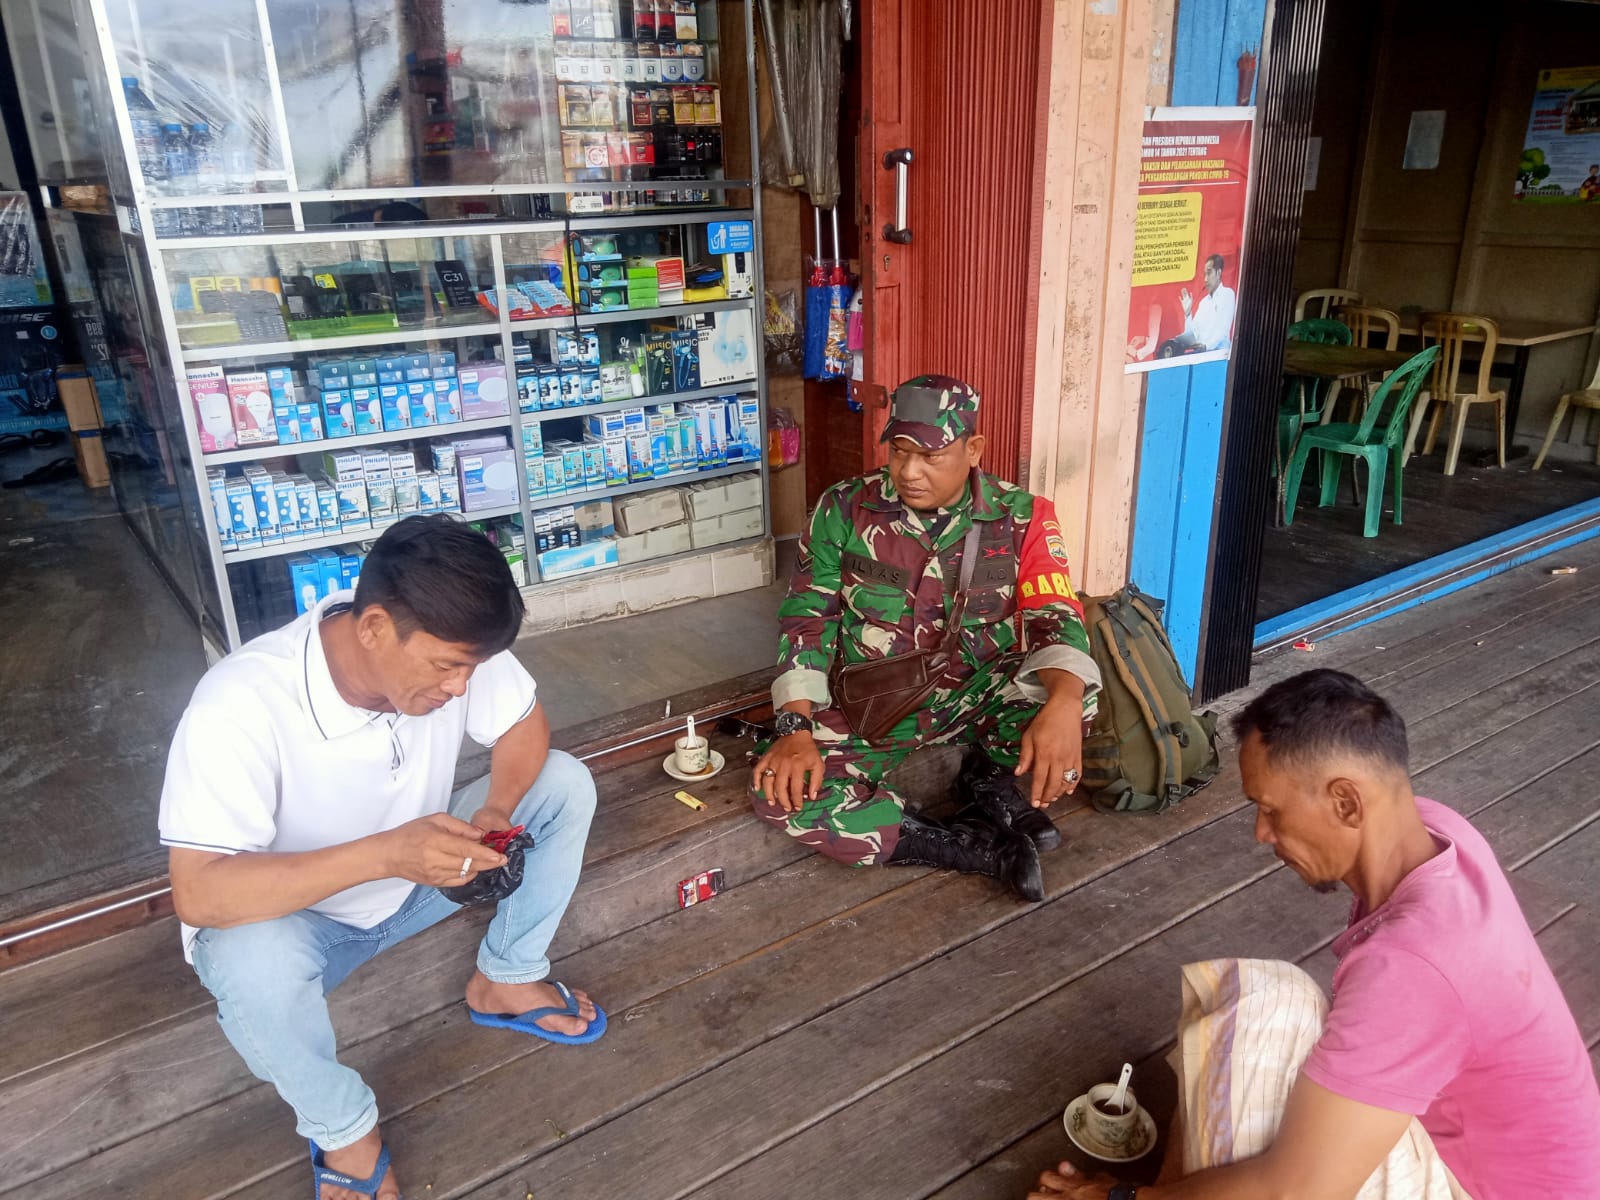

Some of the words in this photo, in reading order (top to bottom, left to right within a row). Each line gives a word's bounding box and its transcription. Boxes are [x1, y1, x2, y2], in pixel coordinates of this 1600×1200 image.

[646, 341, 671, 352] MUSIC
[672, 338, 698, 349] MUSIC
[337, 456, 361, 464] PHILIPS
[364, 456, 389, 464] PHILIPS
[337, 480, 363, 489] PHILIPS
[369, 479, 393, 488] PHILIPS
[851, 557, 900, 585] ILYAS
